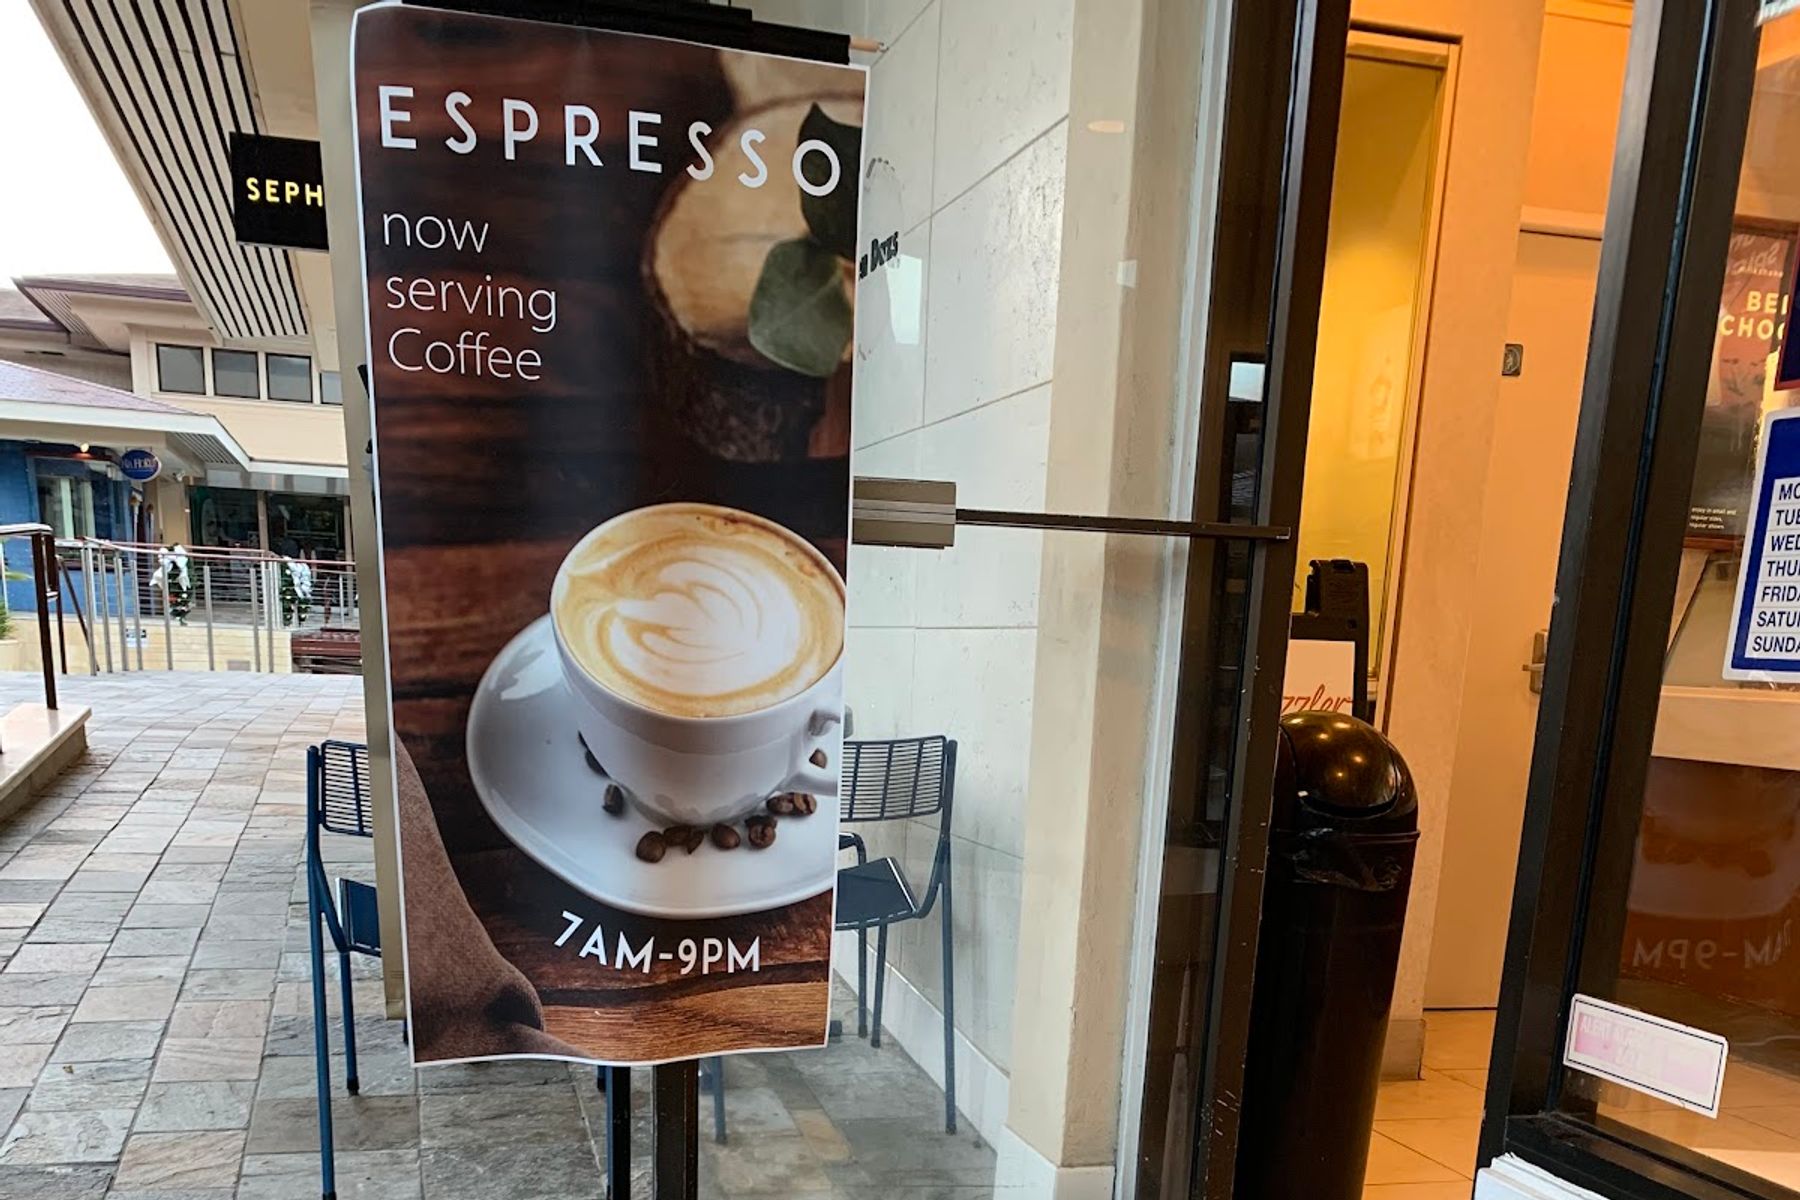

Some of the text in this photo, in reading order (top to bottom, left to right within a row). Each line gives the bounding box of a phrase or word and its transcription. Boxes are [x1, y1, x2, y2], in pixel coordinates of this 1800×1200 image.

[378, 85, 842, 197] ESPRESSO
[246, 177, 323, 207] SEPH
[383, 212, 489, 253] now
[386, 275, 558, 333] serving
[388, 328, 542, 380] Coffee
[1767, 560, 1800, 577] THU
[1761, 586, 1800, 602] FRID
[1756, 611, 1800, 628] SATU
[553, 910, 761, 976] 7AM-9PM
